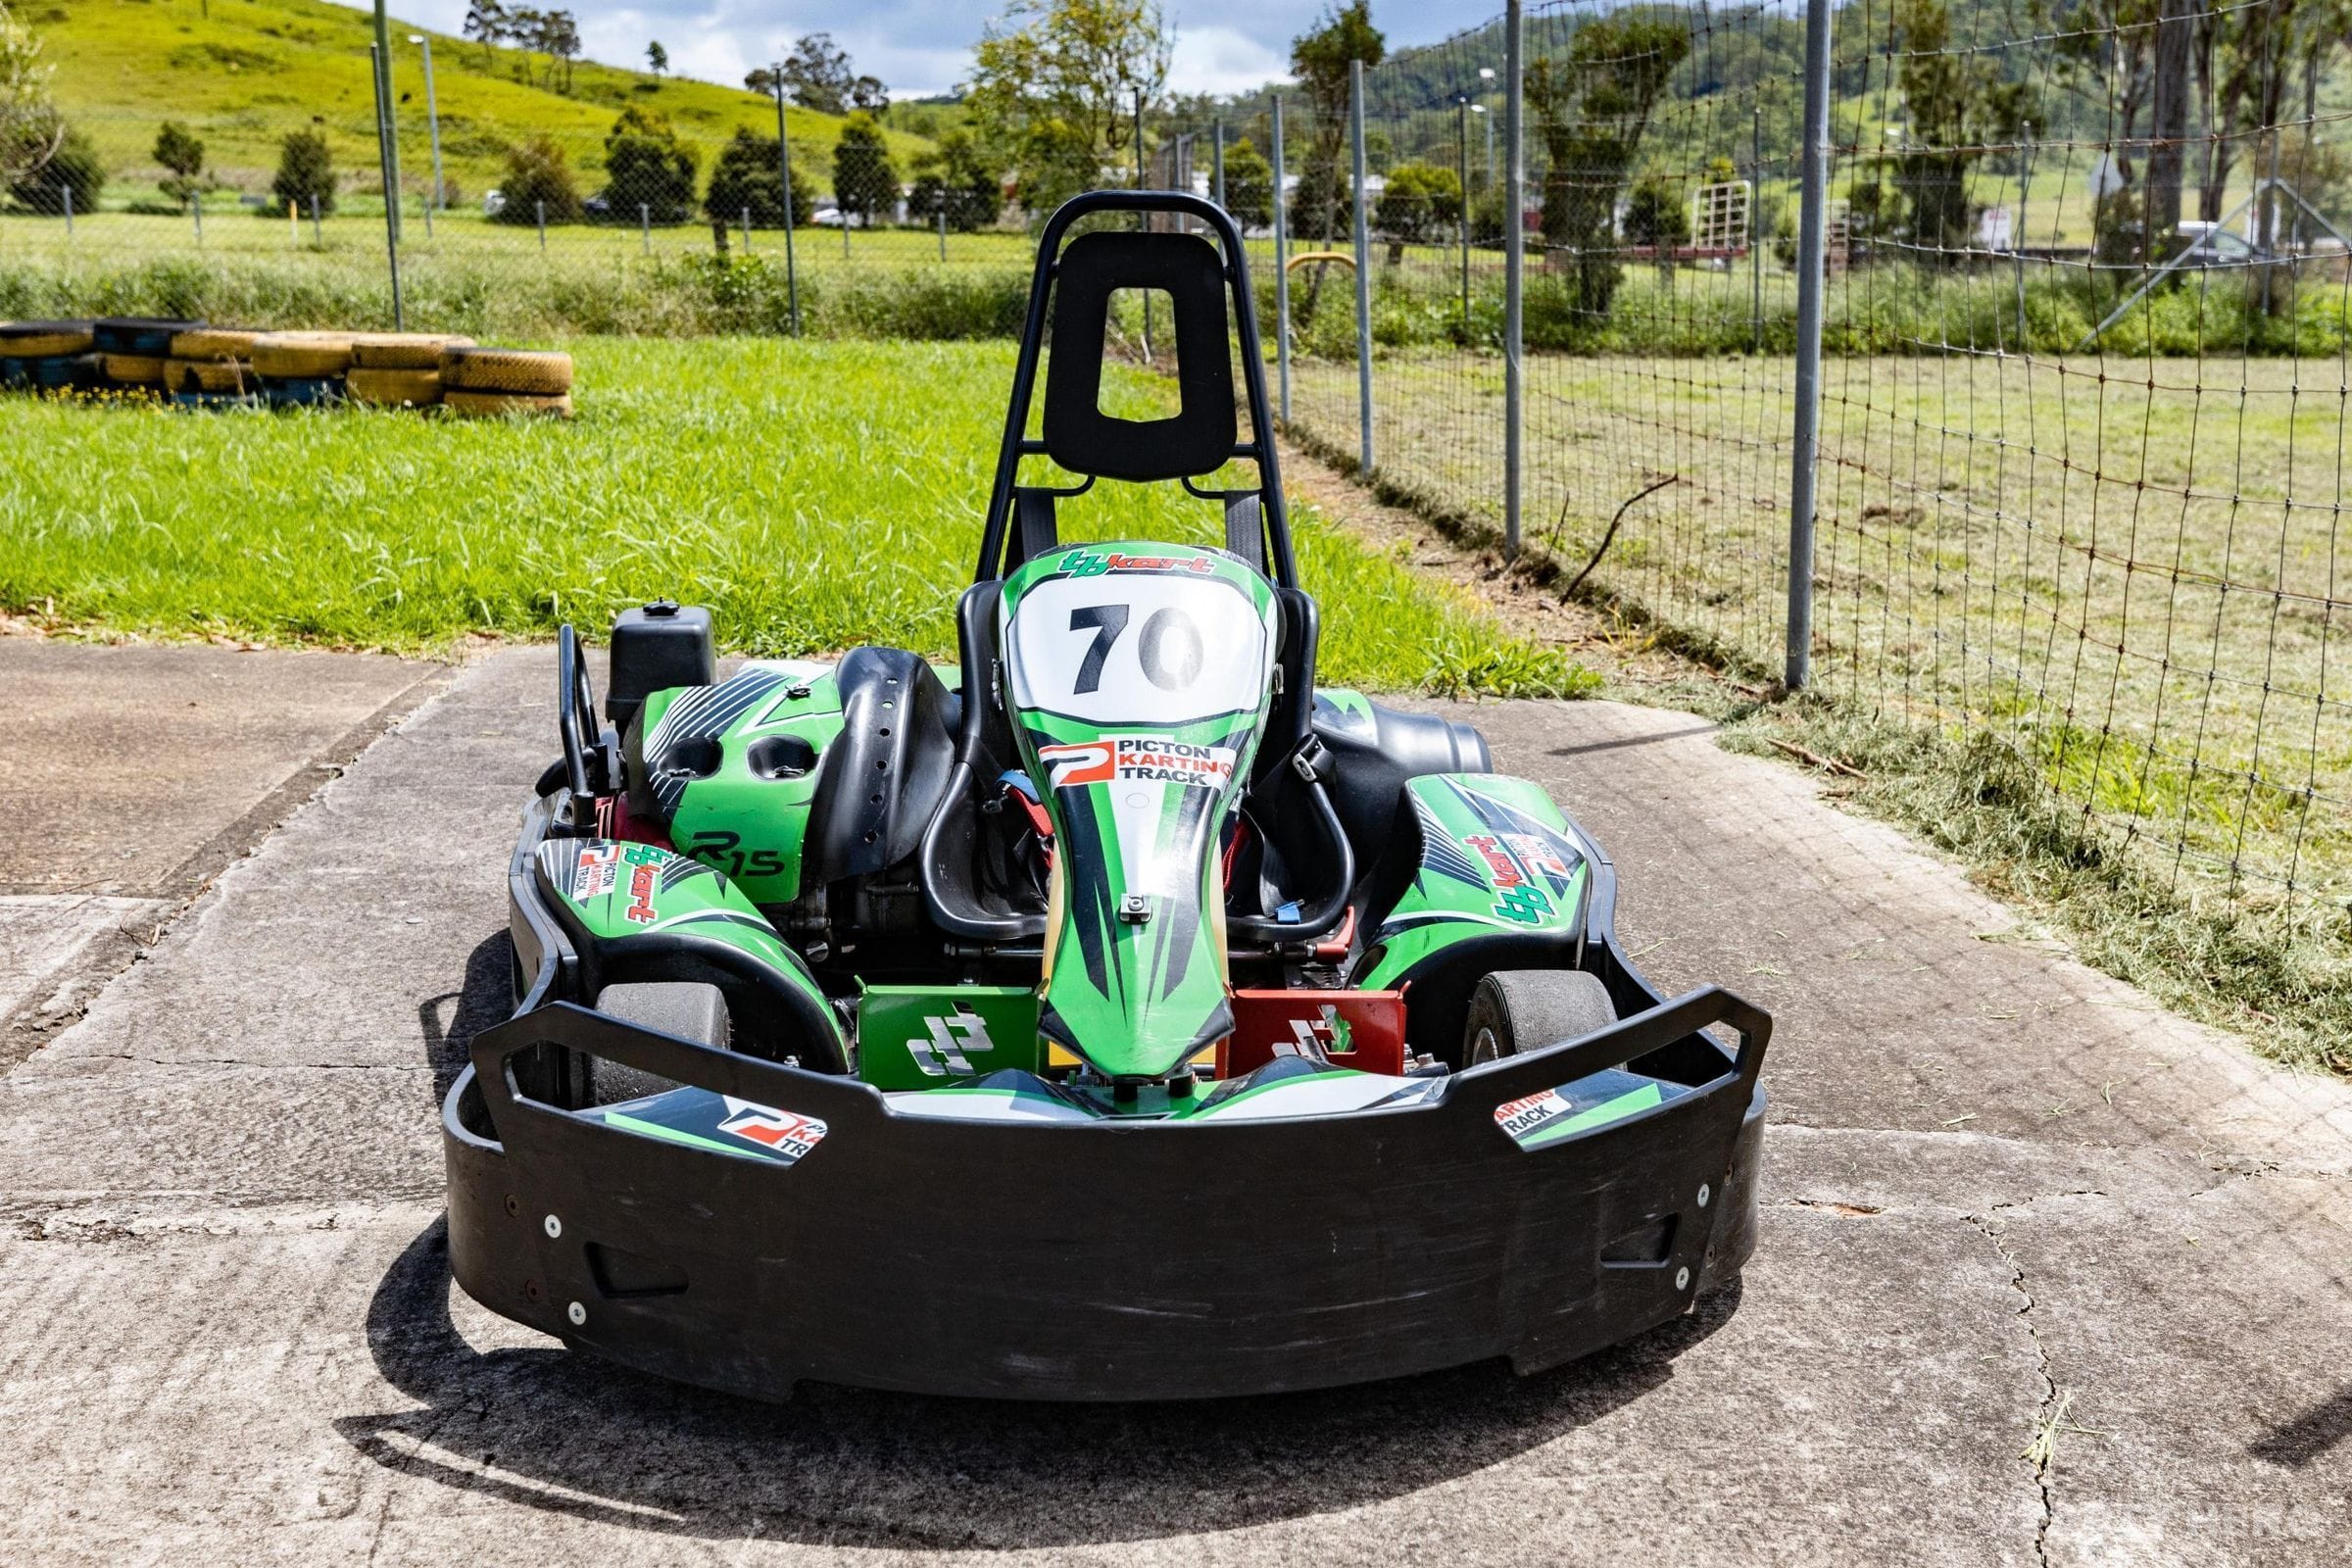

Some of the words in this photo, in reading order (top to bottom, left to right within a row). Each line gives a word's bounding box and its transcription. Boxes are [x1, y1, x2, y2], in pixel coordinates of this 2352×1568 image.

[1069, 603, 1203, 695] 70
[1119, 740, 1210, 760] PICTON
[1119, 754, 1232, 780] KARTING
[1119, 767, 1206, 786] TRACK
